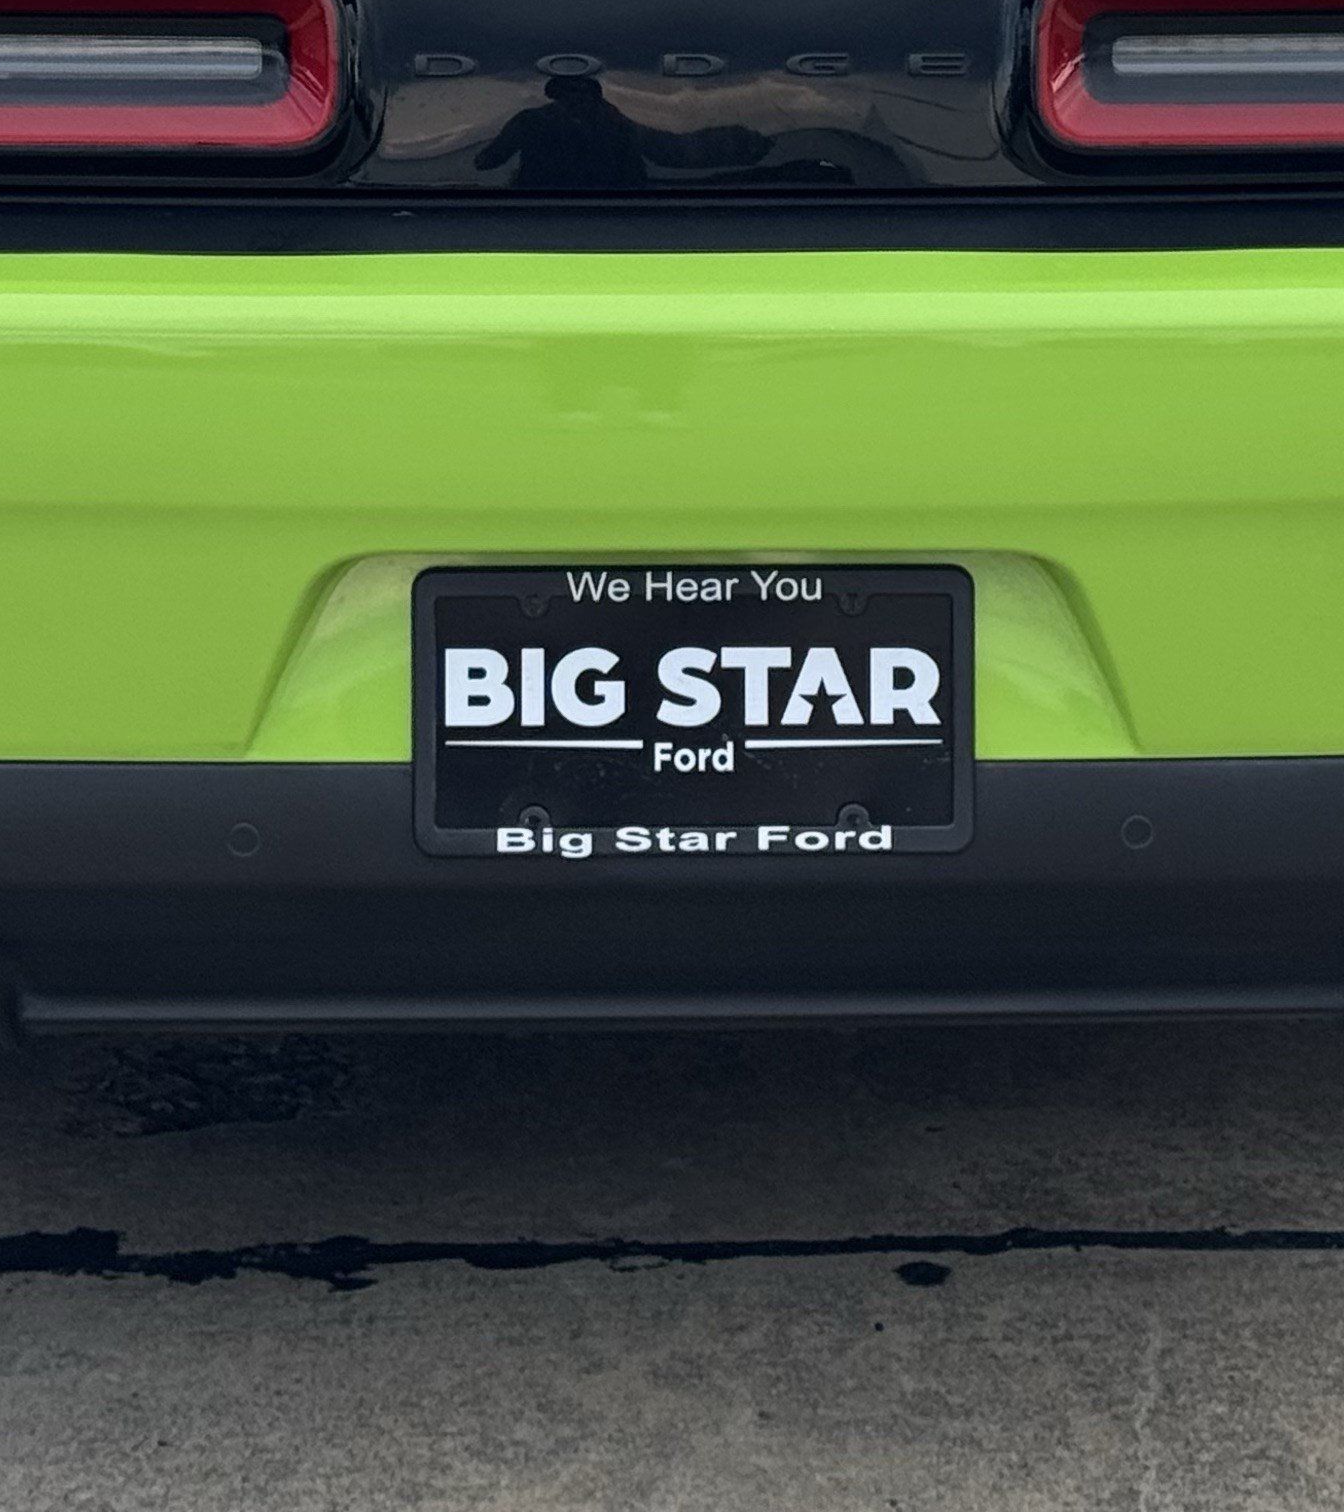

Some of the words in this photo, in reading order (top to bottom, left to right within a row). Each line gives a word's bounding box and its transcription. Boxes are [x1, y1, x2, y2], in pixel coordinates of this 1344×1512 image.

[413, 52, 968, 77] DODGE
[566, 570, 631, 602] We
[645, 570, 740, 602] Hear
[750, 570, 823, 602] You
[444, 646, 626, 727] BIG
[656, 646, 942, 727] STAR
[654, 740, 735, 773] Ford
[496, 826, 593, 859] Big
[615, 826, 738, 853] Star
[757, 824, 893, 852] Ford
